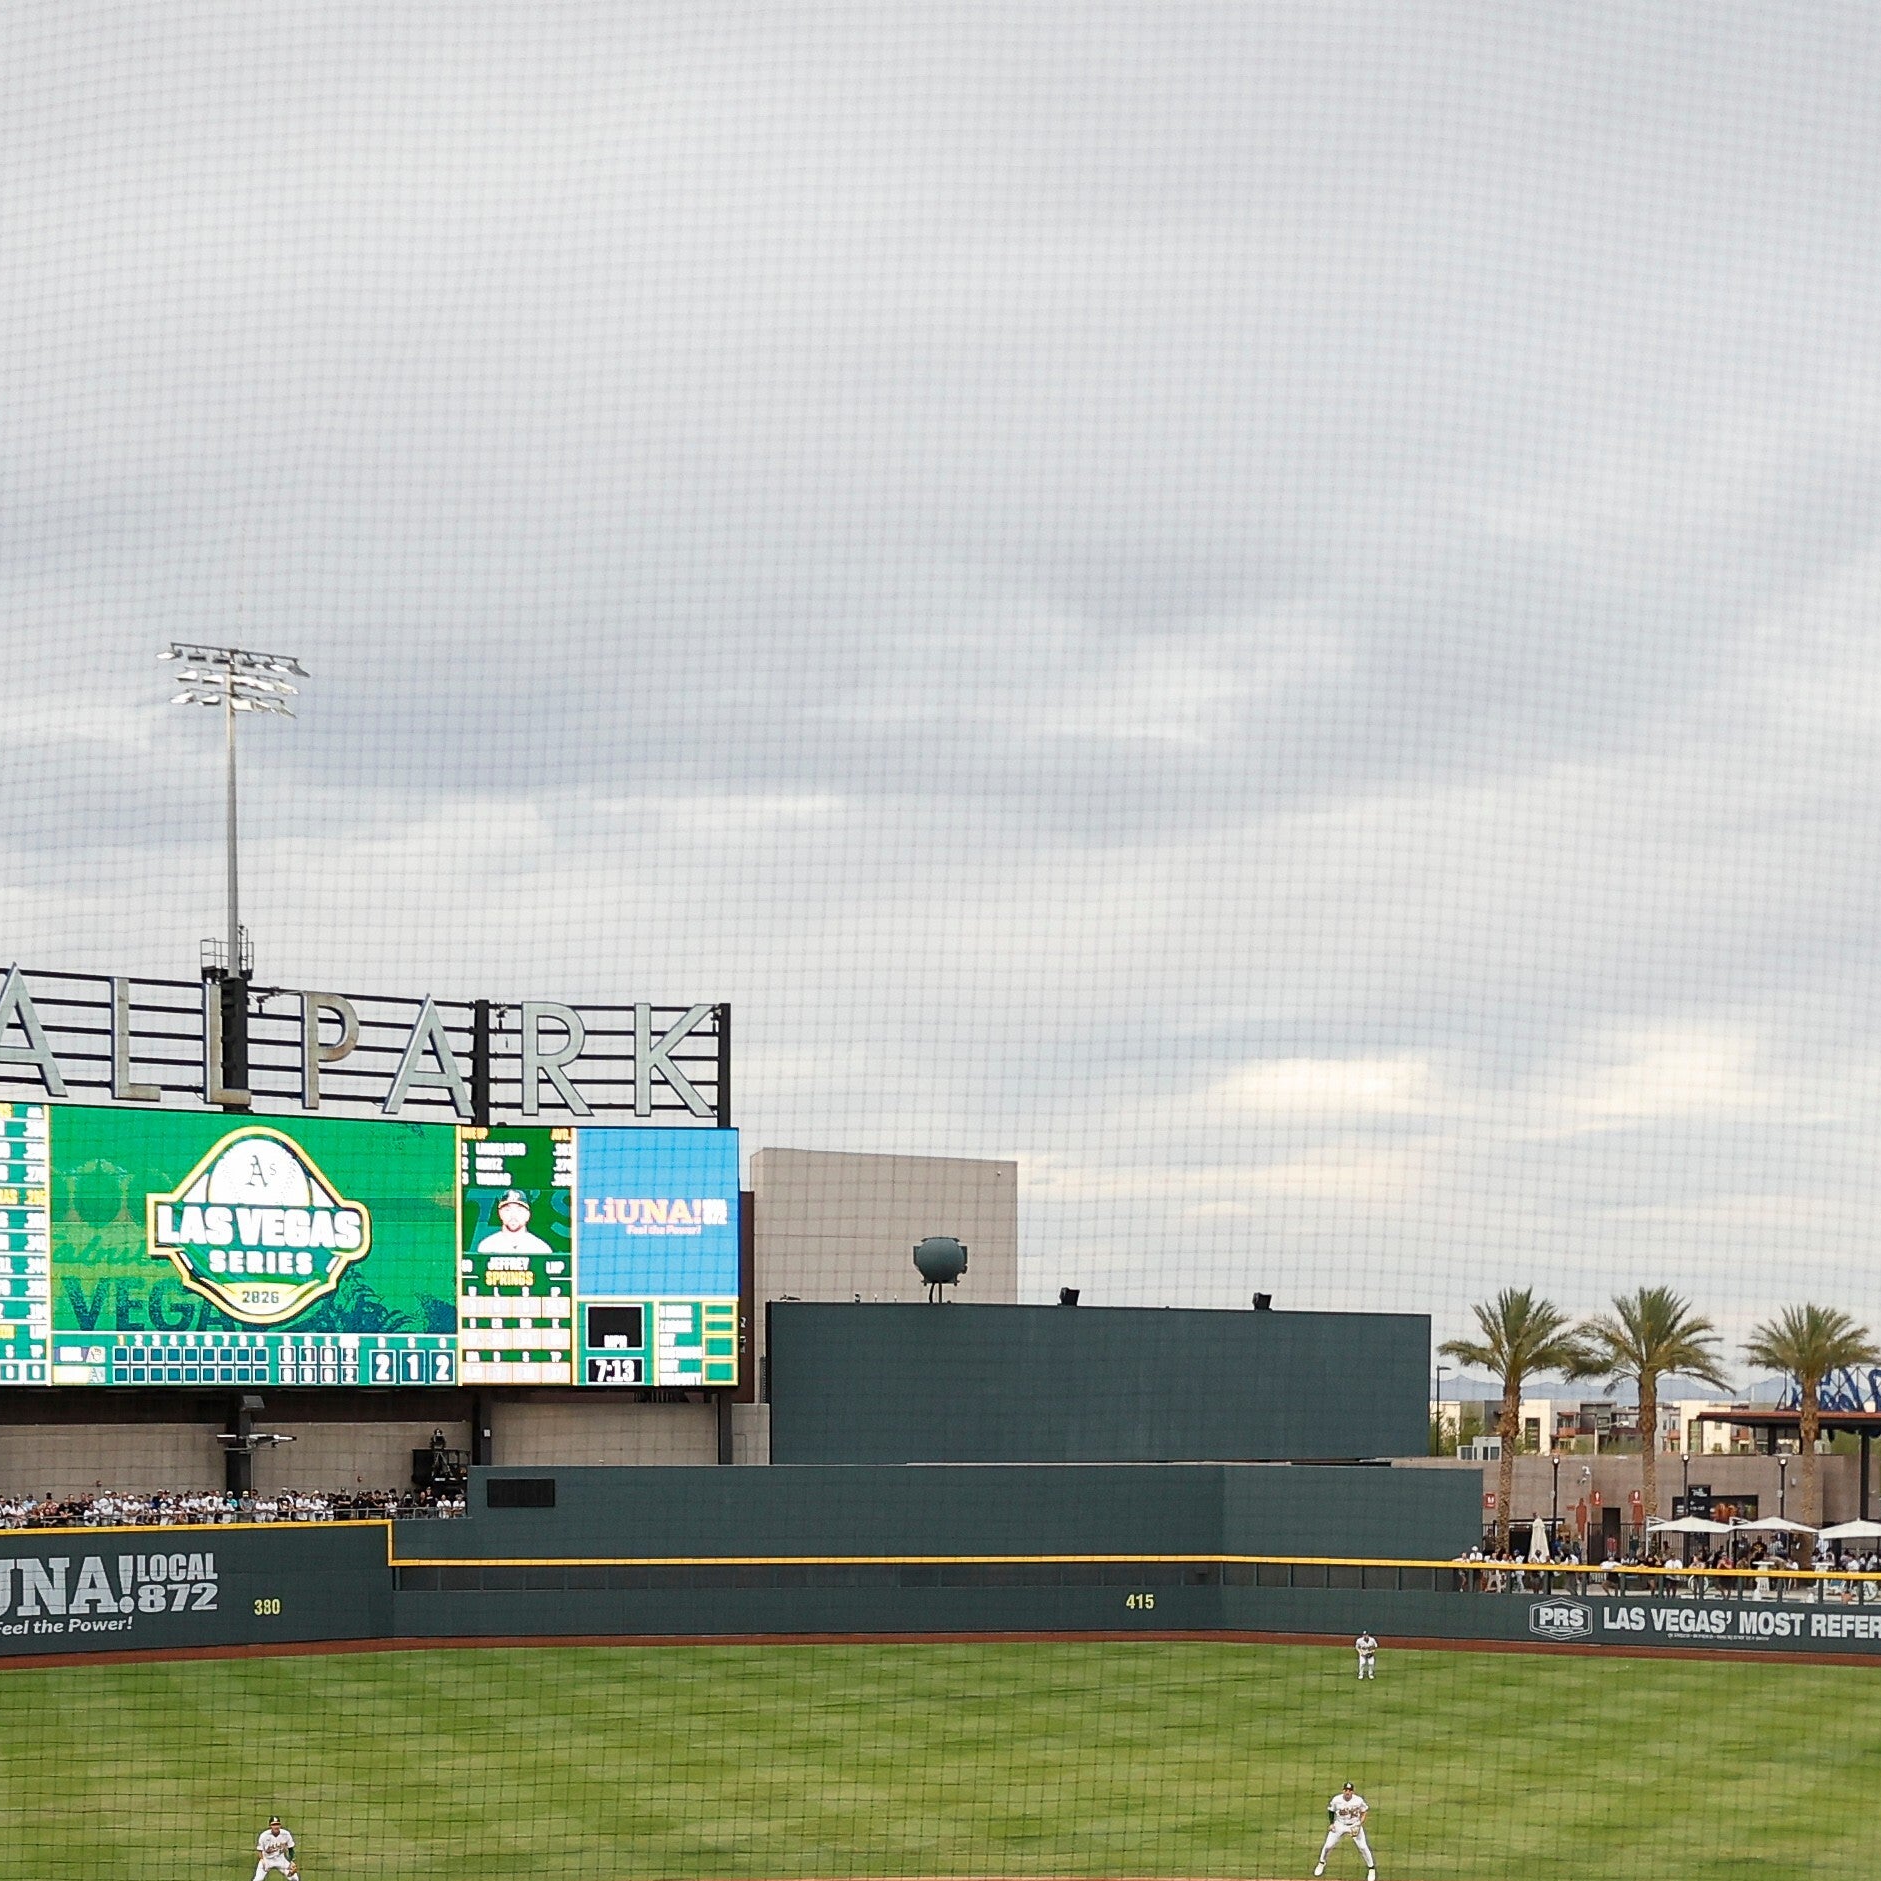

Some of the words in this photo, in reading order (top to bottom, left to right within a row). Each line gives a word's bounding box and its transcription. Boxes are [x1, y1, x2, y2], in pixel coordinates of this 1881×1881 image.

[462, 1143, 468, 1155] 1
[462, 1157, 469, 1170] 2
[584, 1197, 703, 1225] LiUNA!
[157, 1205, 234, 1245] LAS
[235, 1209, 361, 1247] VEGAS
[209, 1251, 313, 1275] SERIES
[487, 1257, 529, 1270] JEFFREY
[485, 1271, 534, 1286] SPRINGS
[242, 1290, 279, 1304] 2026
[134, 1335, 143, 1347] 2
[152, 1335, 160, 1347] 3
[304, 1348, 313, 1363] 1
[345, 1348, 354, 1363] 2
[345, 1368, 354, 1383] 2
[376, 1354, 390, 1381] 2
[407, 1354, 419, 1381] 1
[435, 1355, 449, 1382] 2
[595, 1360, 635, 1382] 7:13
[137, 1552, 218, 1582] LOCAL
[137, 1583, 218, 1613] 872
[254, 1598, 281, 1616] 380
[1126, 1592, 1155, 1609] 415
[33, 1619, 64, 1634] the
[68, 1616, 133, 1633] Power!
[1539, 1608, 1585, 1627] PRS
[1603, 1606, 1646, 1631] LAS
[1739, 1611, 1805, 1636] MOST
